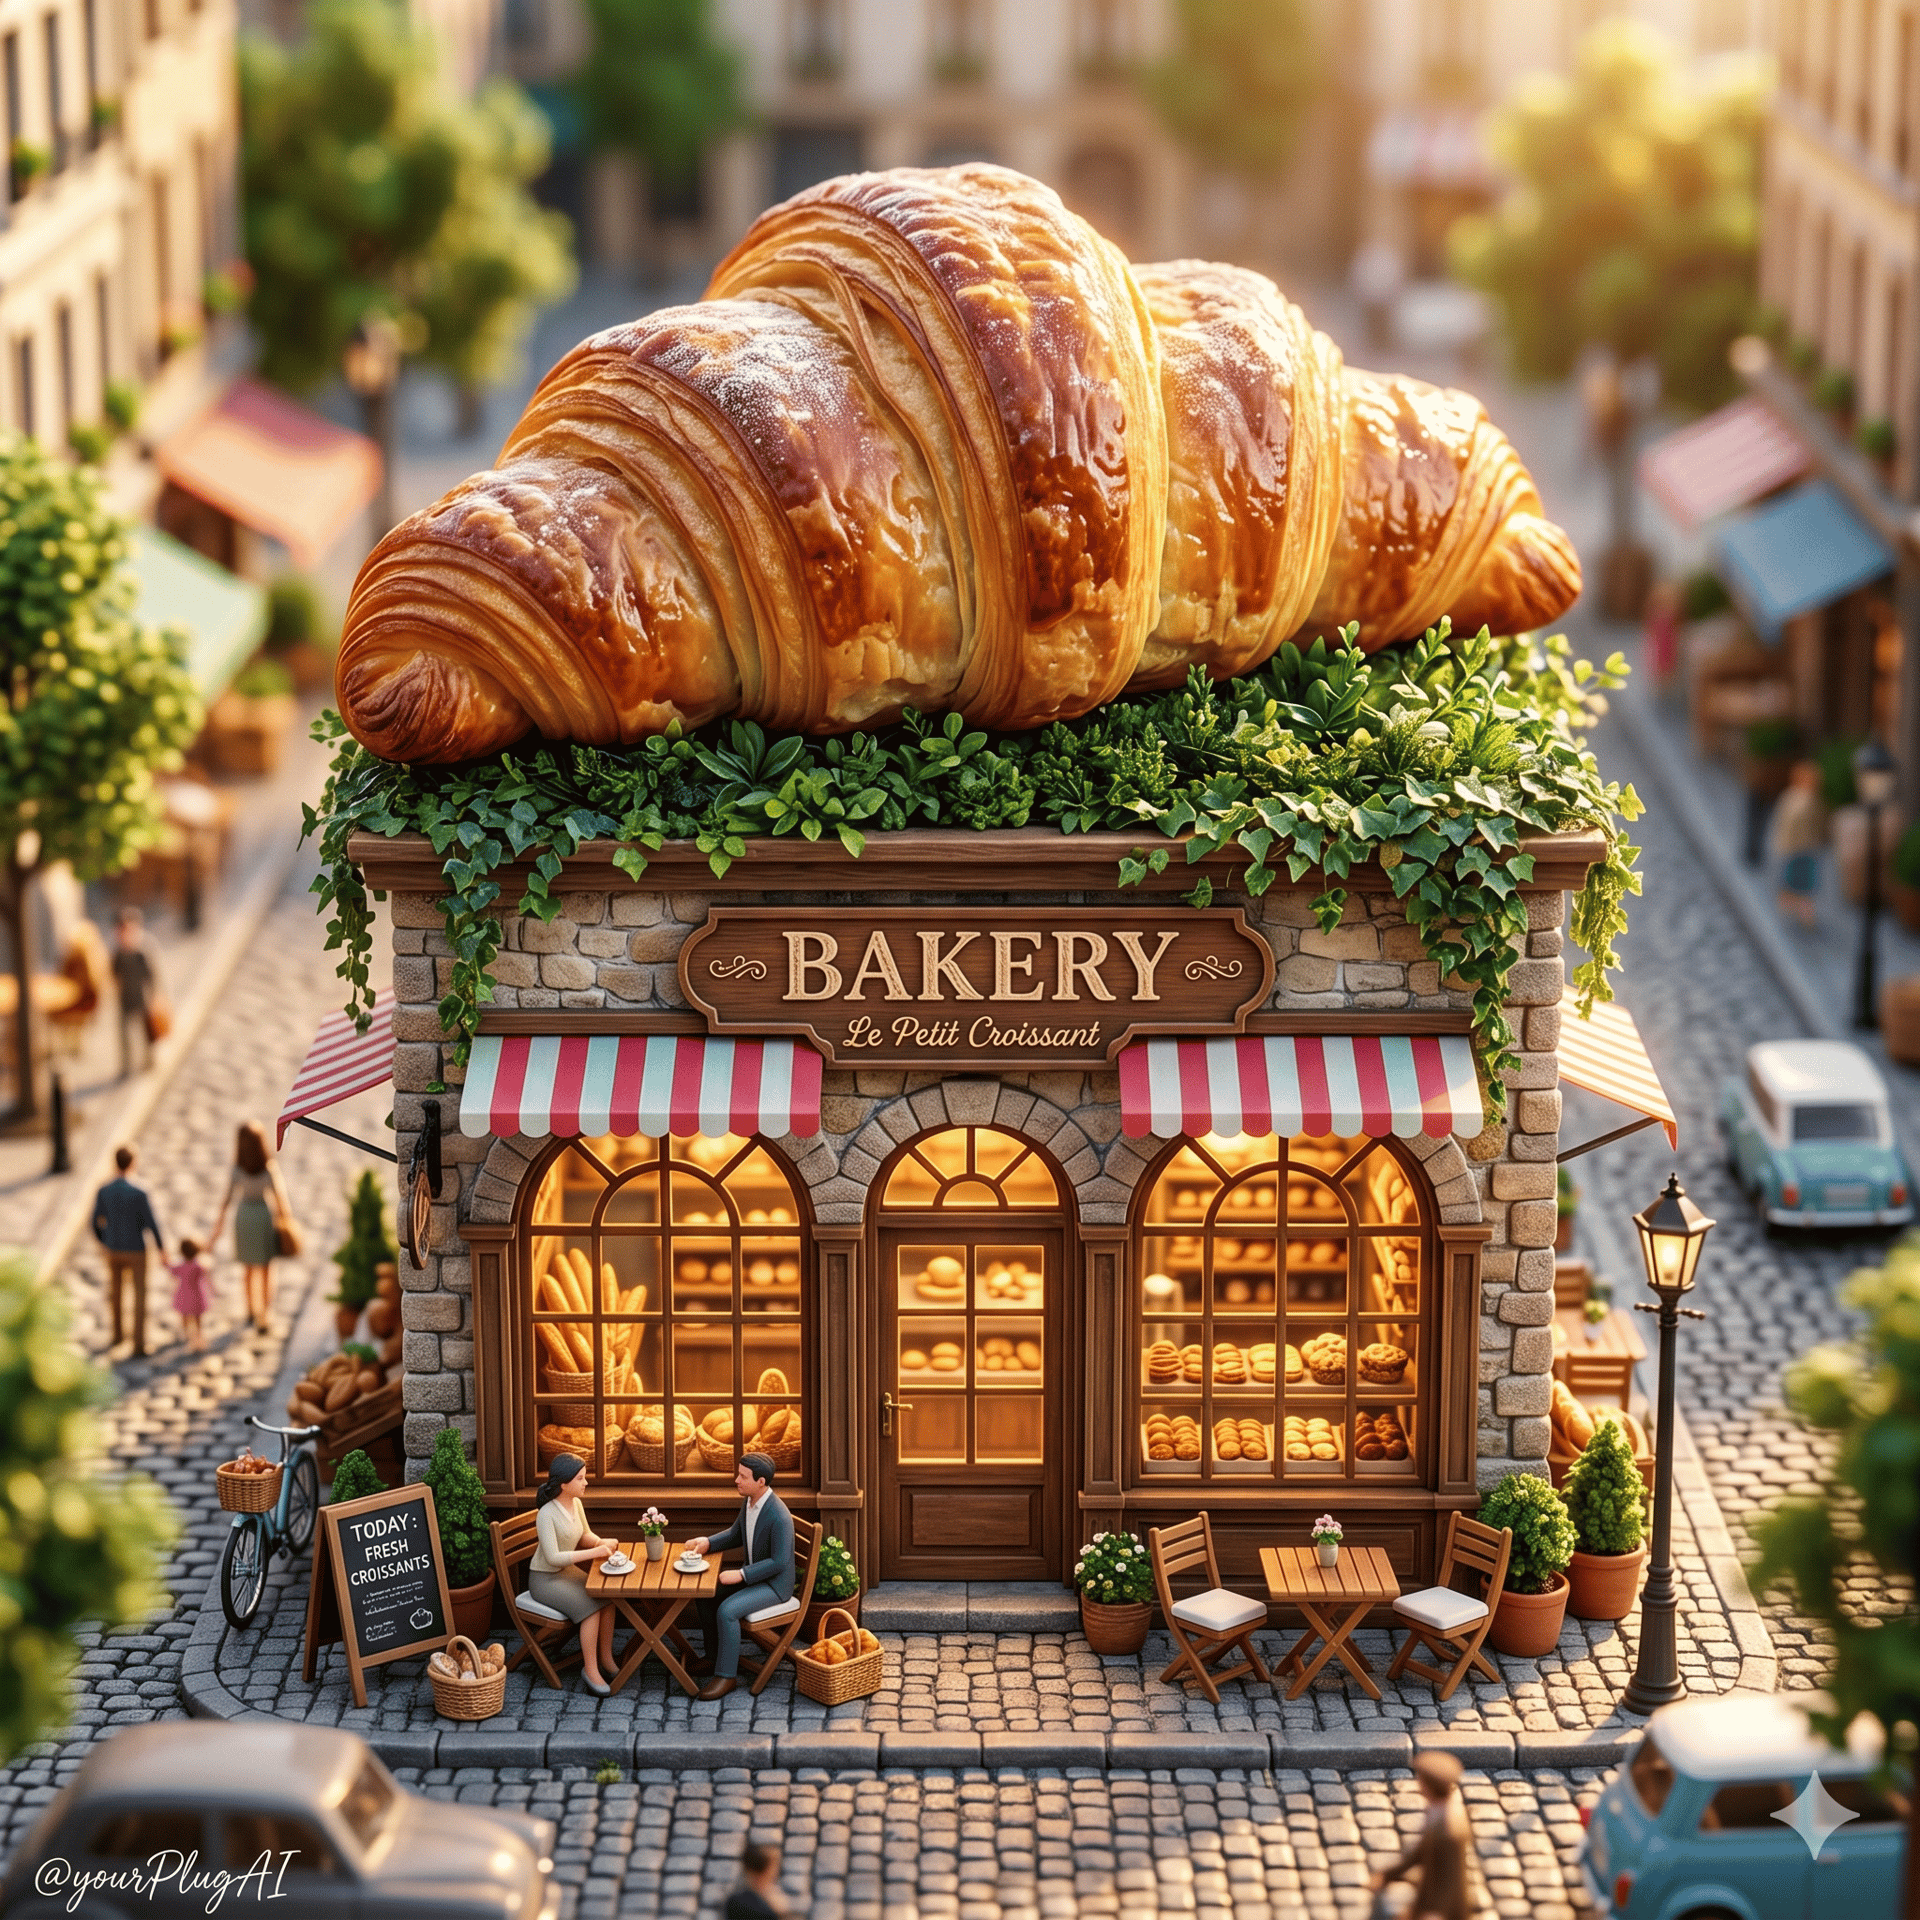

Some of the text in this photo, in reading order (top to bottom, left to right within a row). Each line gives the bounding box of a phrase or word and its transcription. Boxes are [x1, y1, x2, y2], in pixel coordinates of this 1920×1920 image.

[782, 930, 1180, 1001] BAKERY
[842, 1015, 1101, 1048] Le Petit Croissant
[365, 1538, 409, 1562] FRESH
[350, 1554, 430, 1586] CROISSANTS
